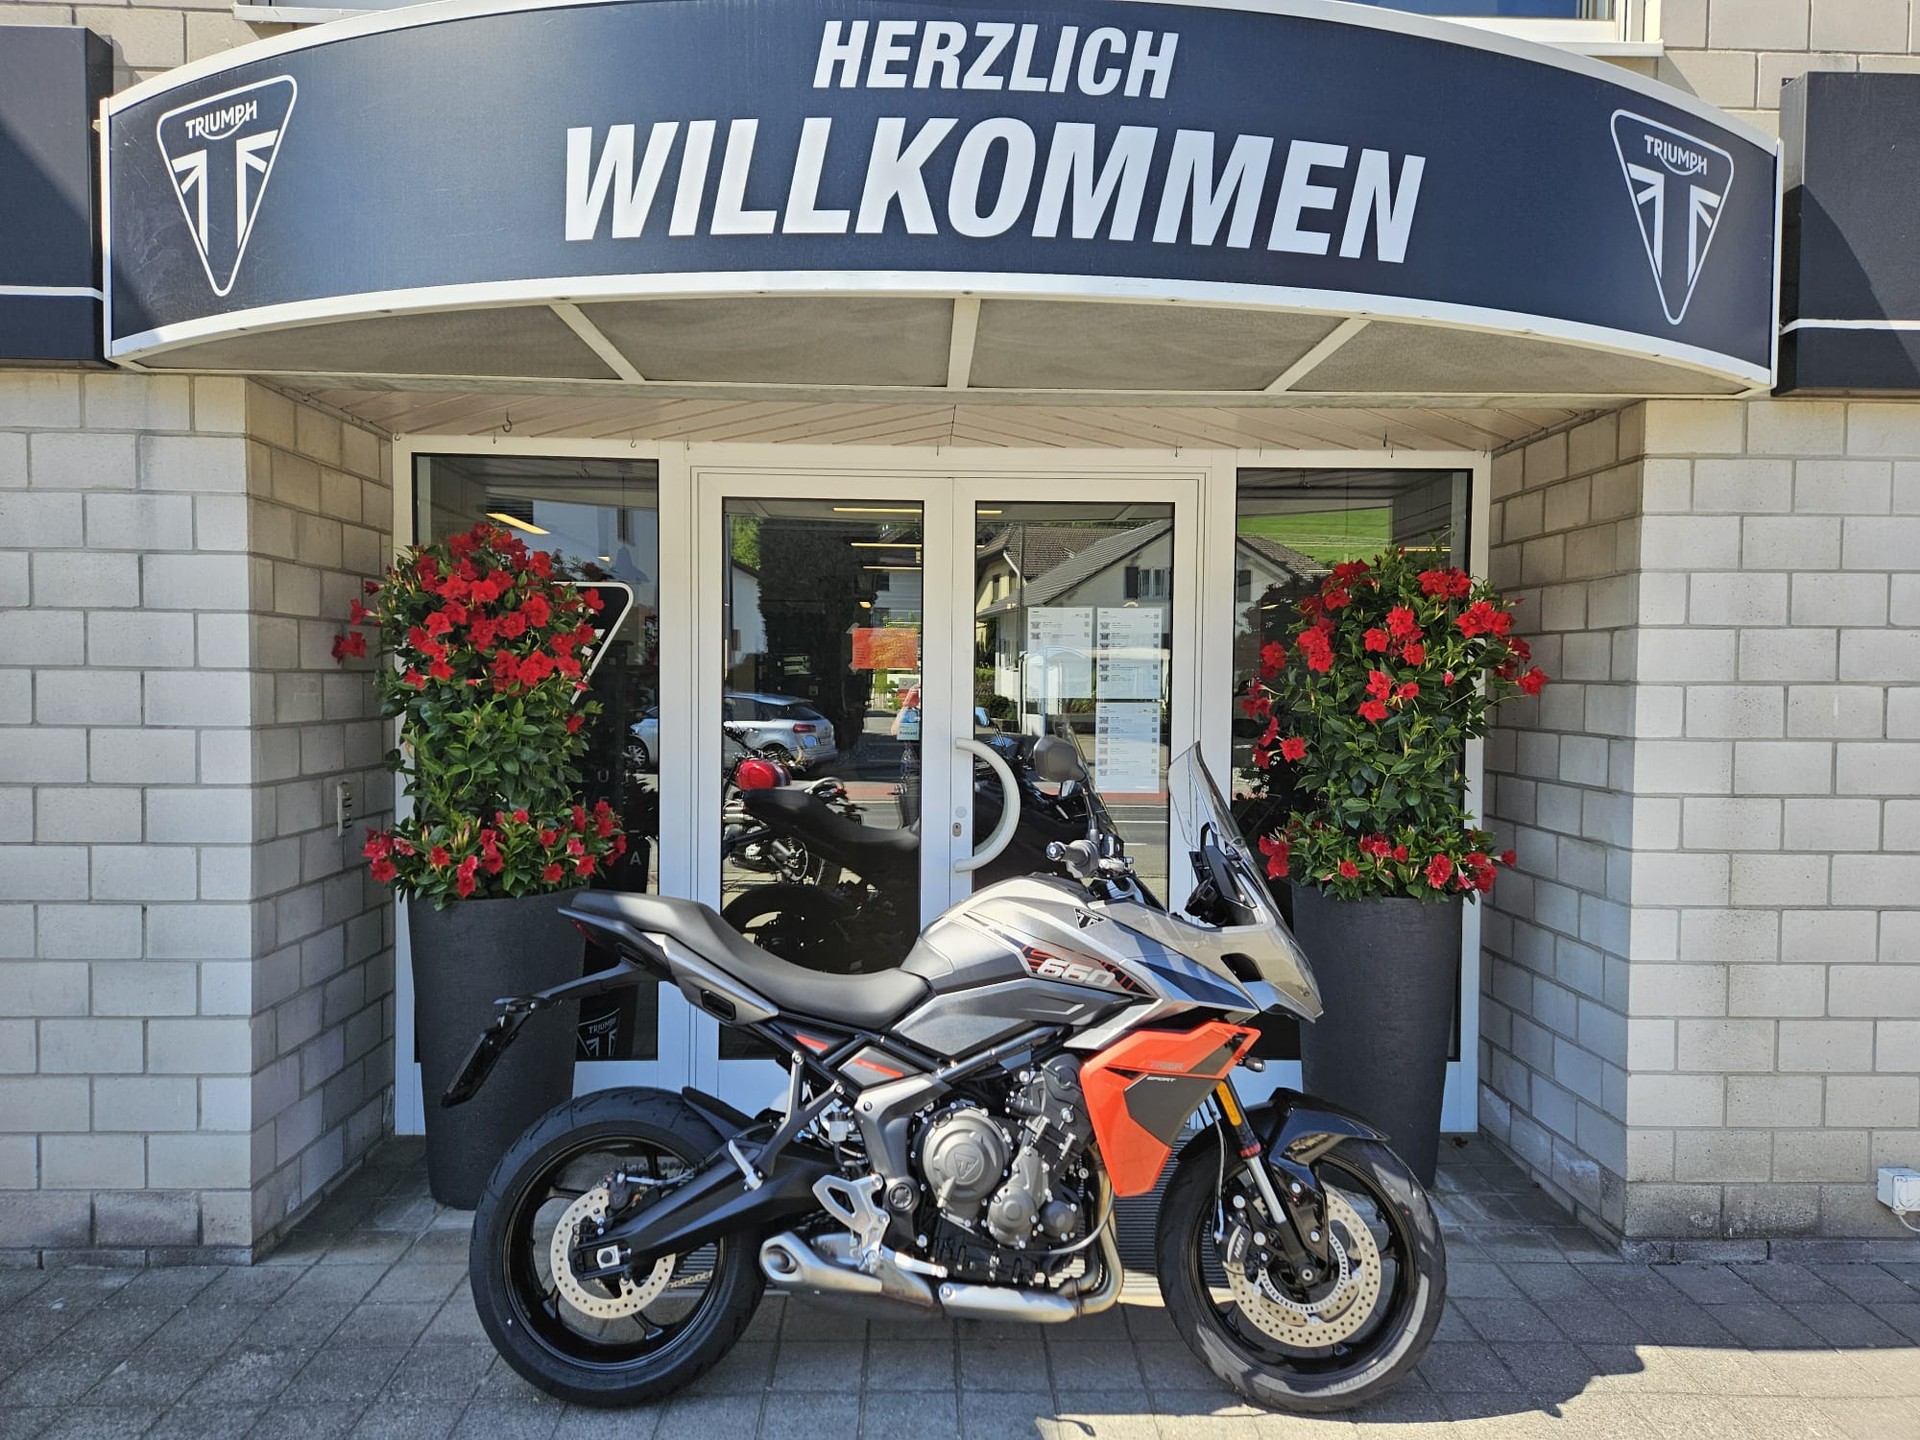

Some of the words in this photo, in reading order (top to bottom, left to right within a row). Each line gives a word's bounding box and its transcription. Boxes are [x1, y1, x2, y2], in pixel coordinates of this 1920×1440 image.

[813, 20, 1179, 99] HERZLICH
[185, 100, 257, 139] TRIUMPH
[1644, 134, 1707, 175] TRIUMPH
[565, 117, 1426, 264] WILLKOMMEN
[1037, 958, 1116, 987] 660
